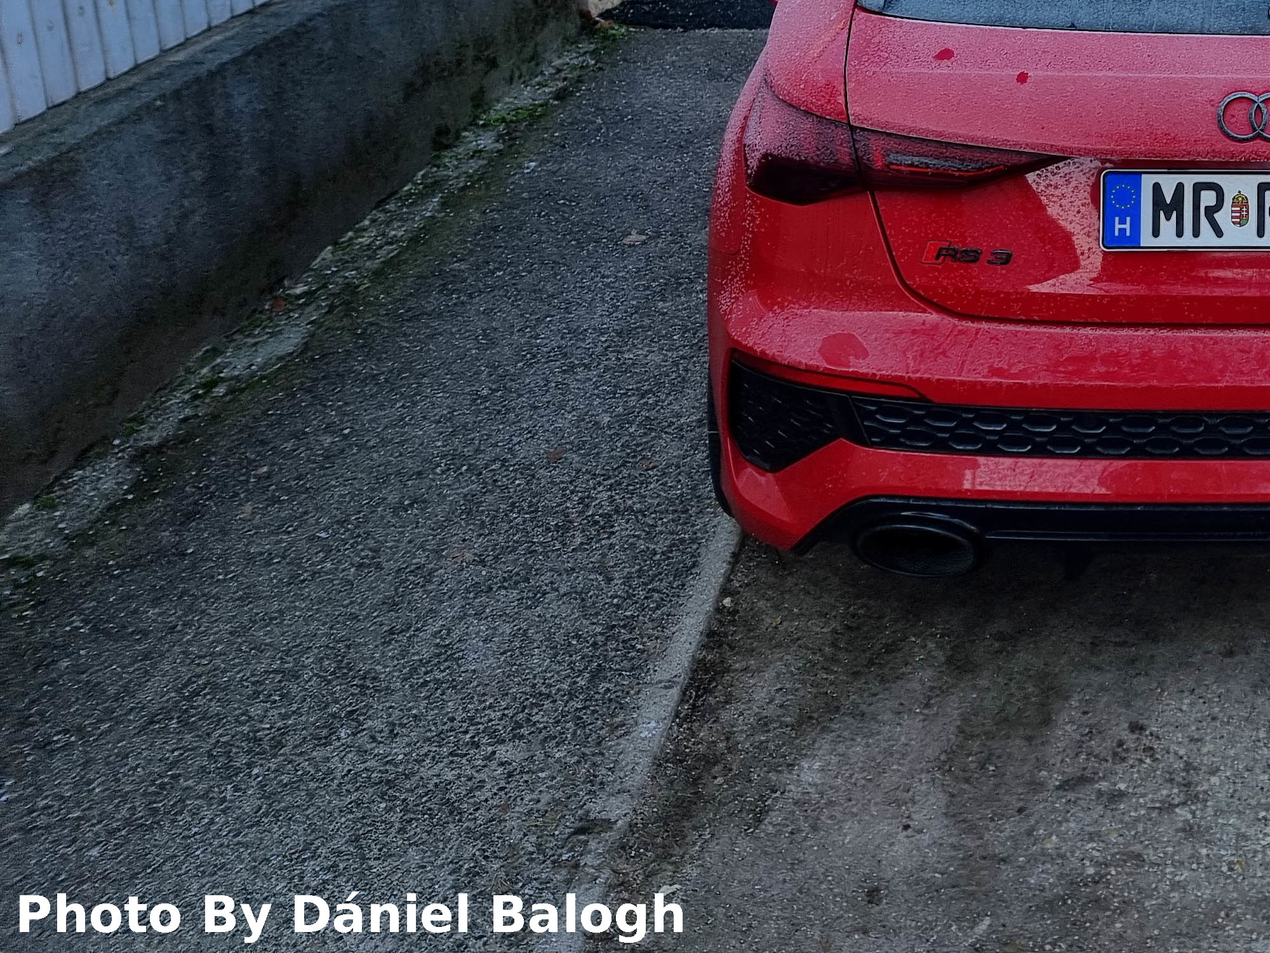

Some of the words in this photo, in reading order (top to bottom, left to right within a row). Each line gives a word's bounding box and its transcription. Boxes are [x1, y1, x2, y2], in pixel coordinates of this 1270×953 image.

[1151, 181, 1224, 239] MR
[1114, 216, 1131, 237] H
[934, 245, 982, 264] RS
[986, 248, 1014, 266] 3
